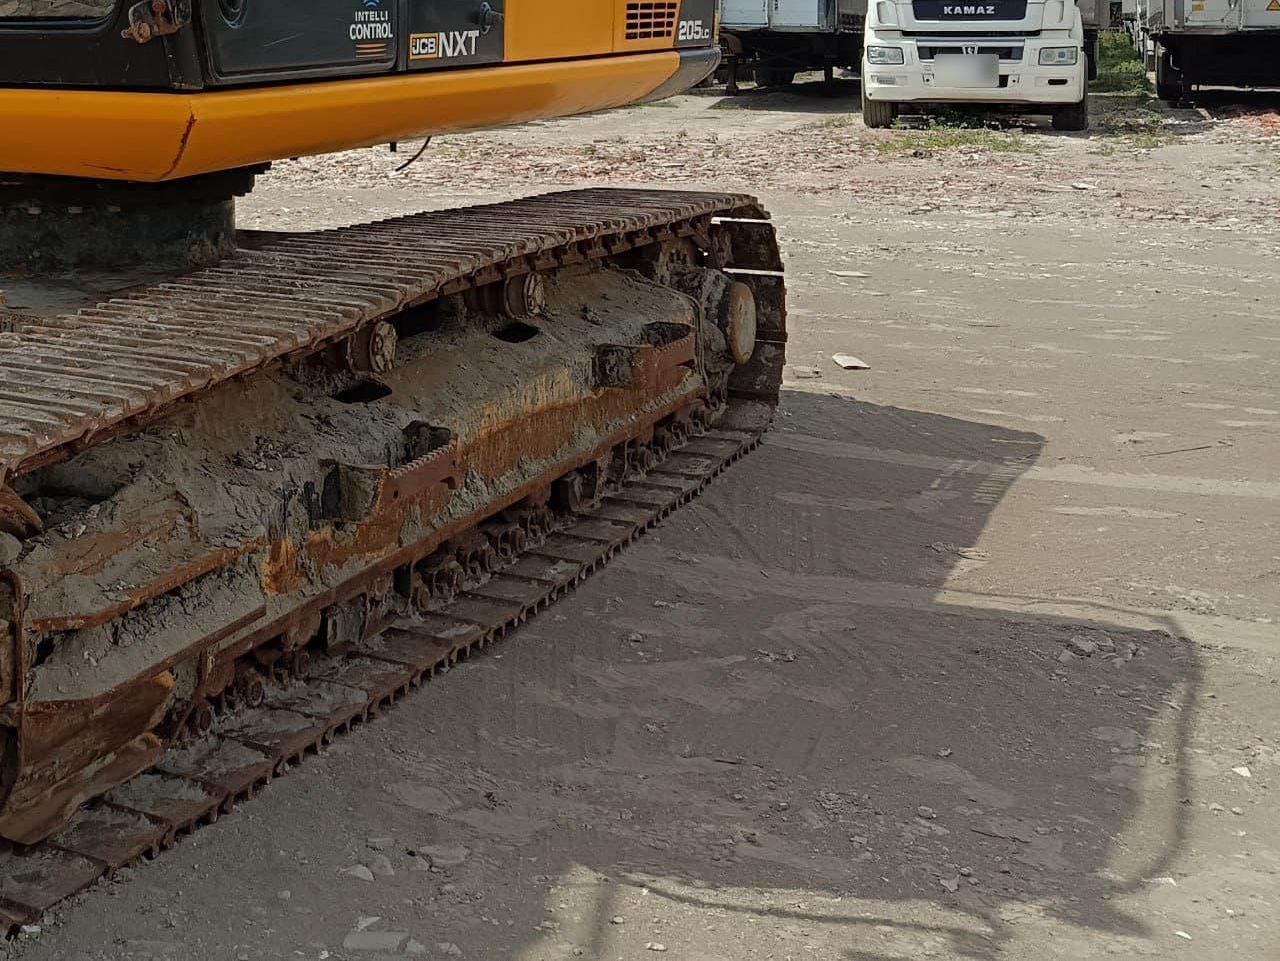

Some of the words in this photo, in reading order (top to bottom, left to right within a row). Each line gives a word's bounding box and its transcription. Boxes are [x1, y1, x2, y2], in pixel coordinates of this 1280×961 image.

[355, 10, 389, 22] INTELLI
[943, 6, 996, 15] KAMAZ
[349, 22, 393, 40] CONTROL
[412, 37, 436, 55] JCB
[438, 30, 480, 58] NXT
